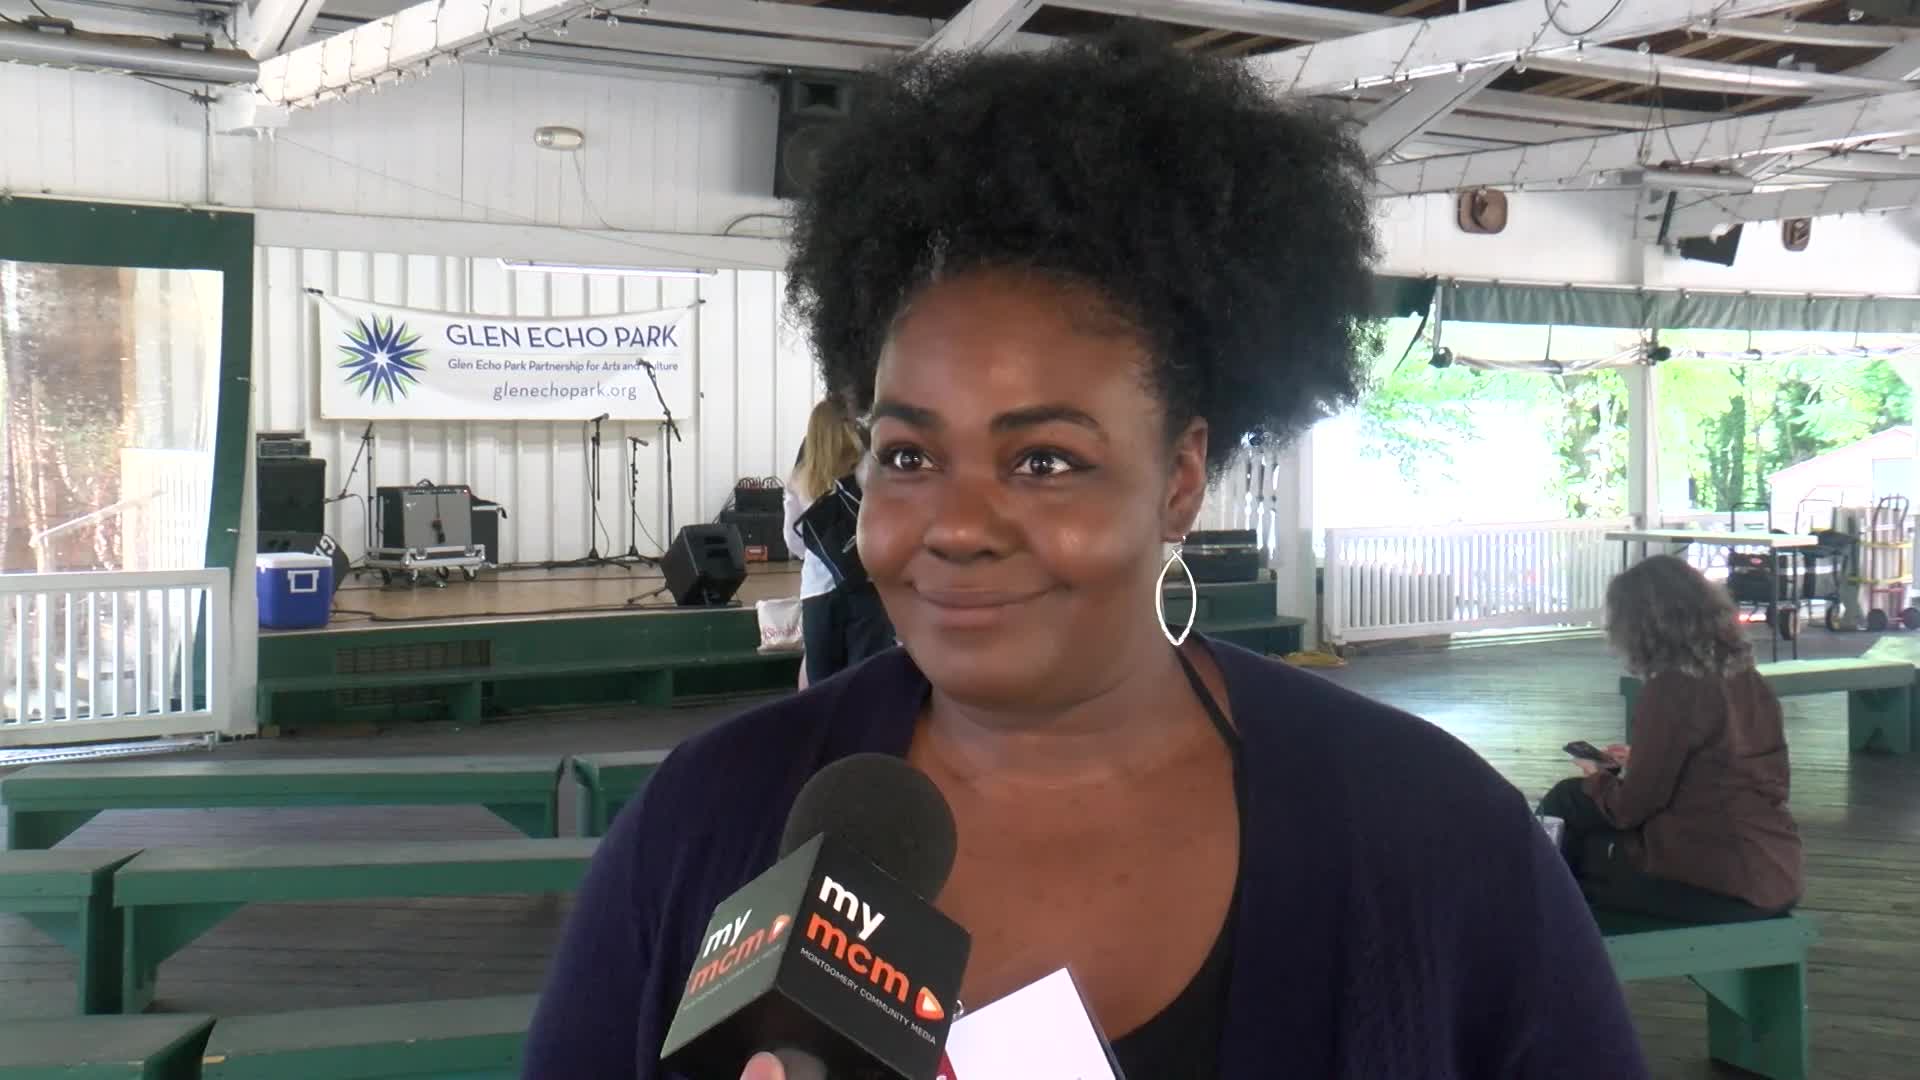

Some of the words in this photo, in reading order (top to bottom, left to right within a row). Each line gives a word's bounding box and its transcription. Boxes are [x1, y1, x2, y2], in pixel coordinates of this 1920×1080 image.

[446, 324, 521, 348] GLEN
[528, 326, 608, 349] ECHO
[614, 324, 678, 348] PARK
[448, 359, 474, 371] Glen
[475, 359, 502, 371] Echo
[504, 359, 527, 372] Park
[528, 360, 584, 374] Partnership
[586, 360, 600, 372] for
[601, 360, 621, 372] Arts
[622, 360, 640, 371] and
[644, 360, 678, 372] ulture
[493, 380, 637, 402] glenechopark.org
[702, 908, 753, 959] my
[818, 875, 886, 940] my
[689, 928, 766, 996] mcm
[806, 911, 910, 1003] mcm
[800, 947, 858, 990] MONTGOMERY
[859, 986, 910, 1026] COMMUNITY
[910, 1022, 937, 1045] MEDIA
